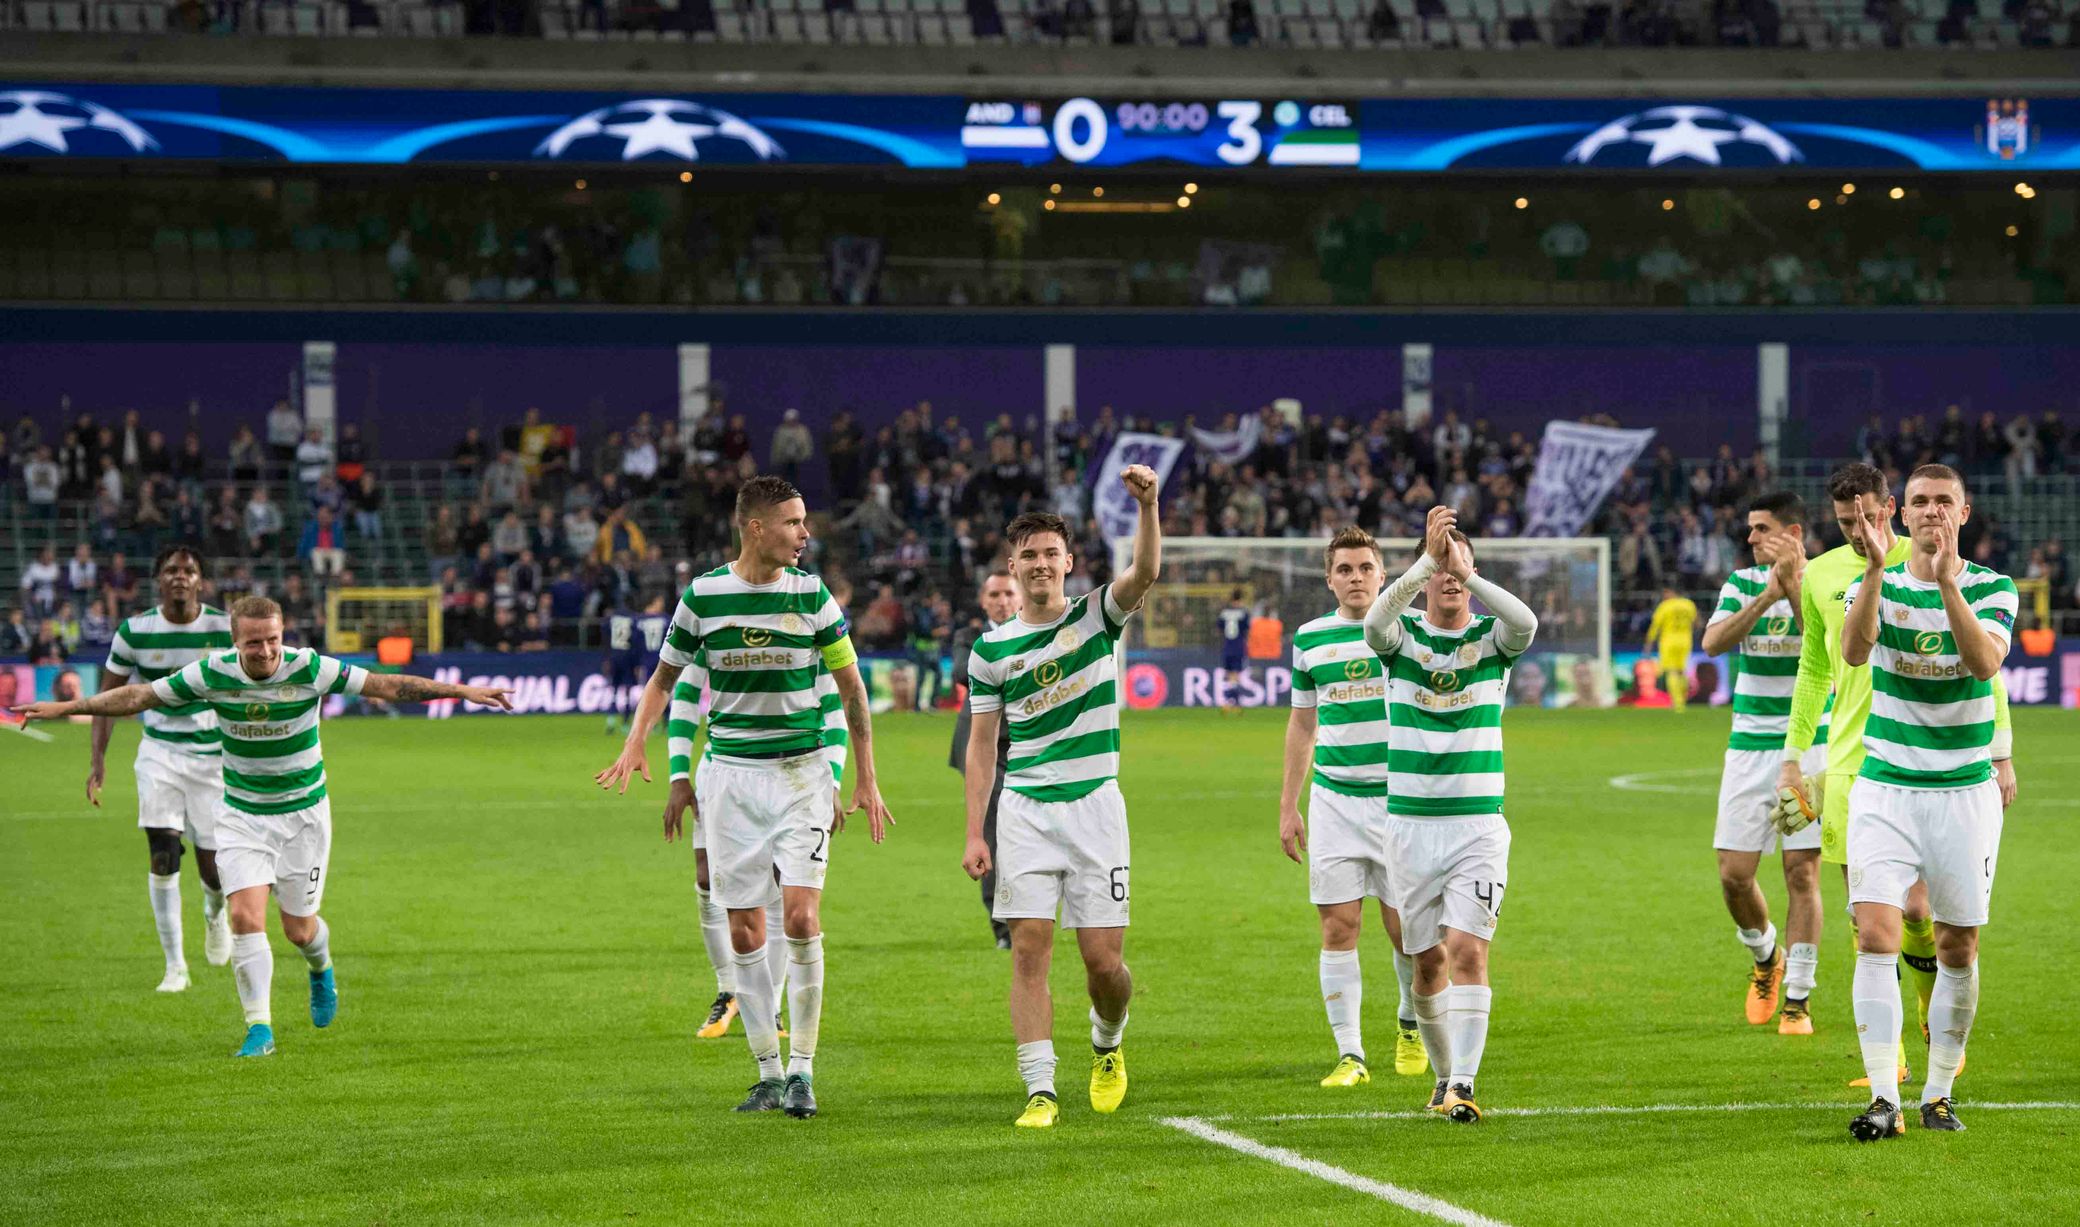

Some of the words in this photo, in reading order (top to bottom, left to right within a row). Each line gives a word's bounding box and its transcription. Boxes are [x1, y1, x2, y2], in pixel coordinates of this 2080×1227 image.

[965, 102, 1015, 124] AND
[1117, 102, 1209, 131] 90:00
[1309, 105, 1352, 127] CEL
[1053, 97, 1108, 163] 0
[1216, 100, 1262, 165] 3
[722, 652, 793, 669] dafabet
[1894, 656, 1962, 677] dafabet
[1023, 675, 1089, 715] dafabet
[1182, 666, 1292, 707] RESP
[1329, 684, 1385, 701] dafabe
[1414, 689, 1474, 710] dafabet
[230, 723, 291, 739] dafabet
[307, 867, 320, 895] 9
